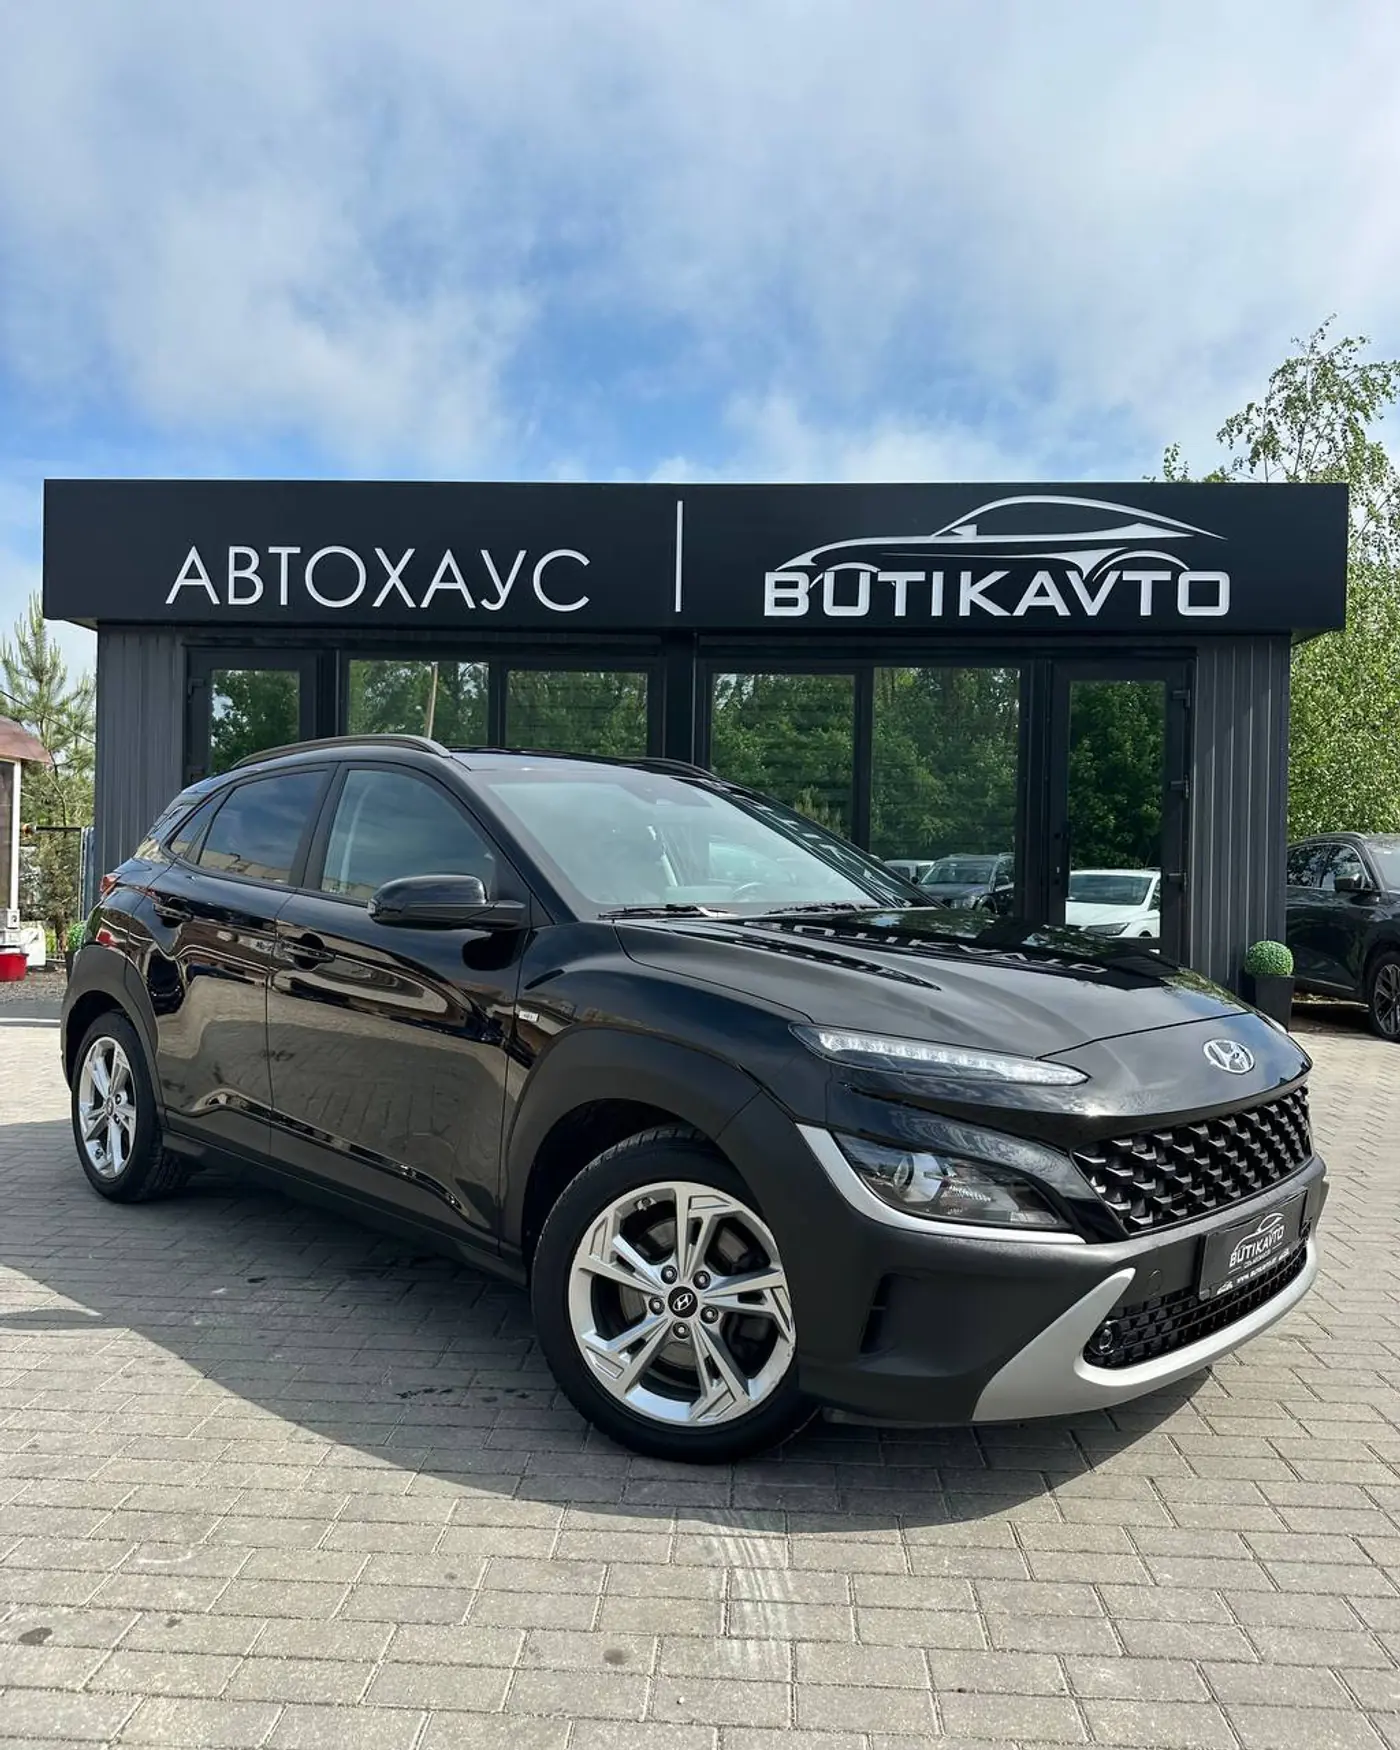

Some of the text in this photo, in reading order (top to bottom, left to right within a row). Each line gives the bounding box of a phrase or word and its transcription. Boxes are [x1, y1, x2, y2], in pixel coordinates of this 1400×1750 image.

[165, 545, 591, 612] АВТОХАУС
[763, 570, 1231, 617] BUTIKAVTO
[1229, 1224, 1285, 1268] BUTIKAVTO
